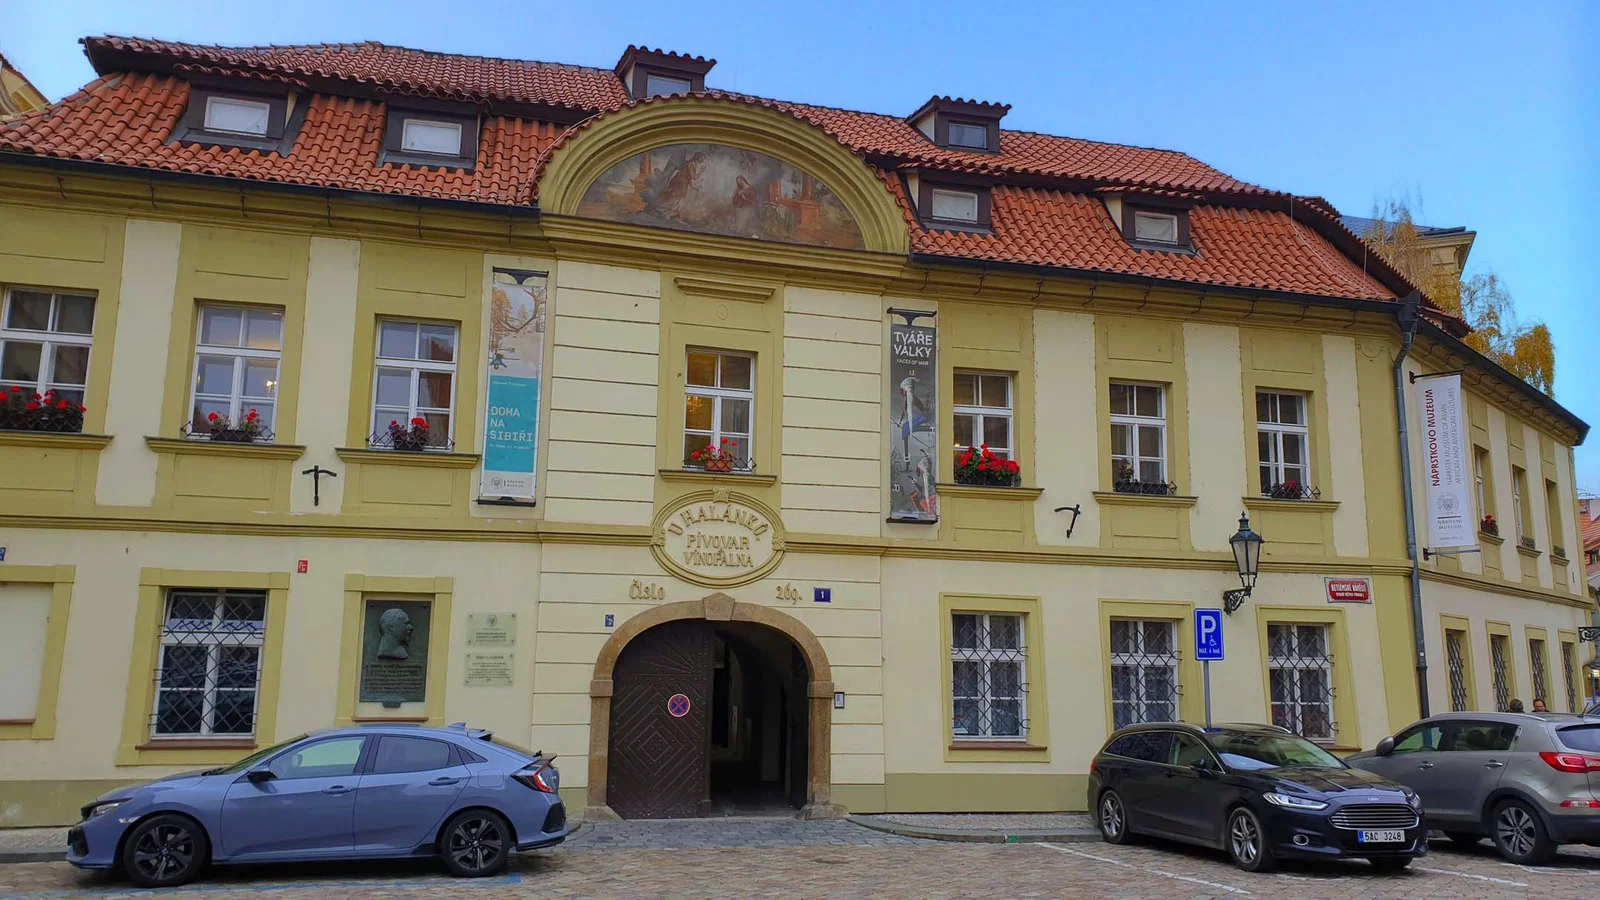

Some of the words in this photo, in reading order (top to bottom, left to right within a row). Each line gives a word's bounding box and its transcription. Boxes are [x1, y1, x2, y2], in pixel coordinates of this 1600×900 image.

[894, 331, 932, 345] TVÁŘE
[491, 407, 520, 417] DOMA
[1425, 388, 1436, 428] MUZEUM
[490, 419, 505, 428] NA
[490, 430, 533, 442] SIBIŘI
[667, 523, 684, 536] U
[820, 590, 825, 599] 1
[1201, 615, 1217, 644] P
[1365, 832, 1378, 841] 5AC
[1384, 832, 1401, 841] 3248
